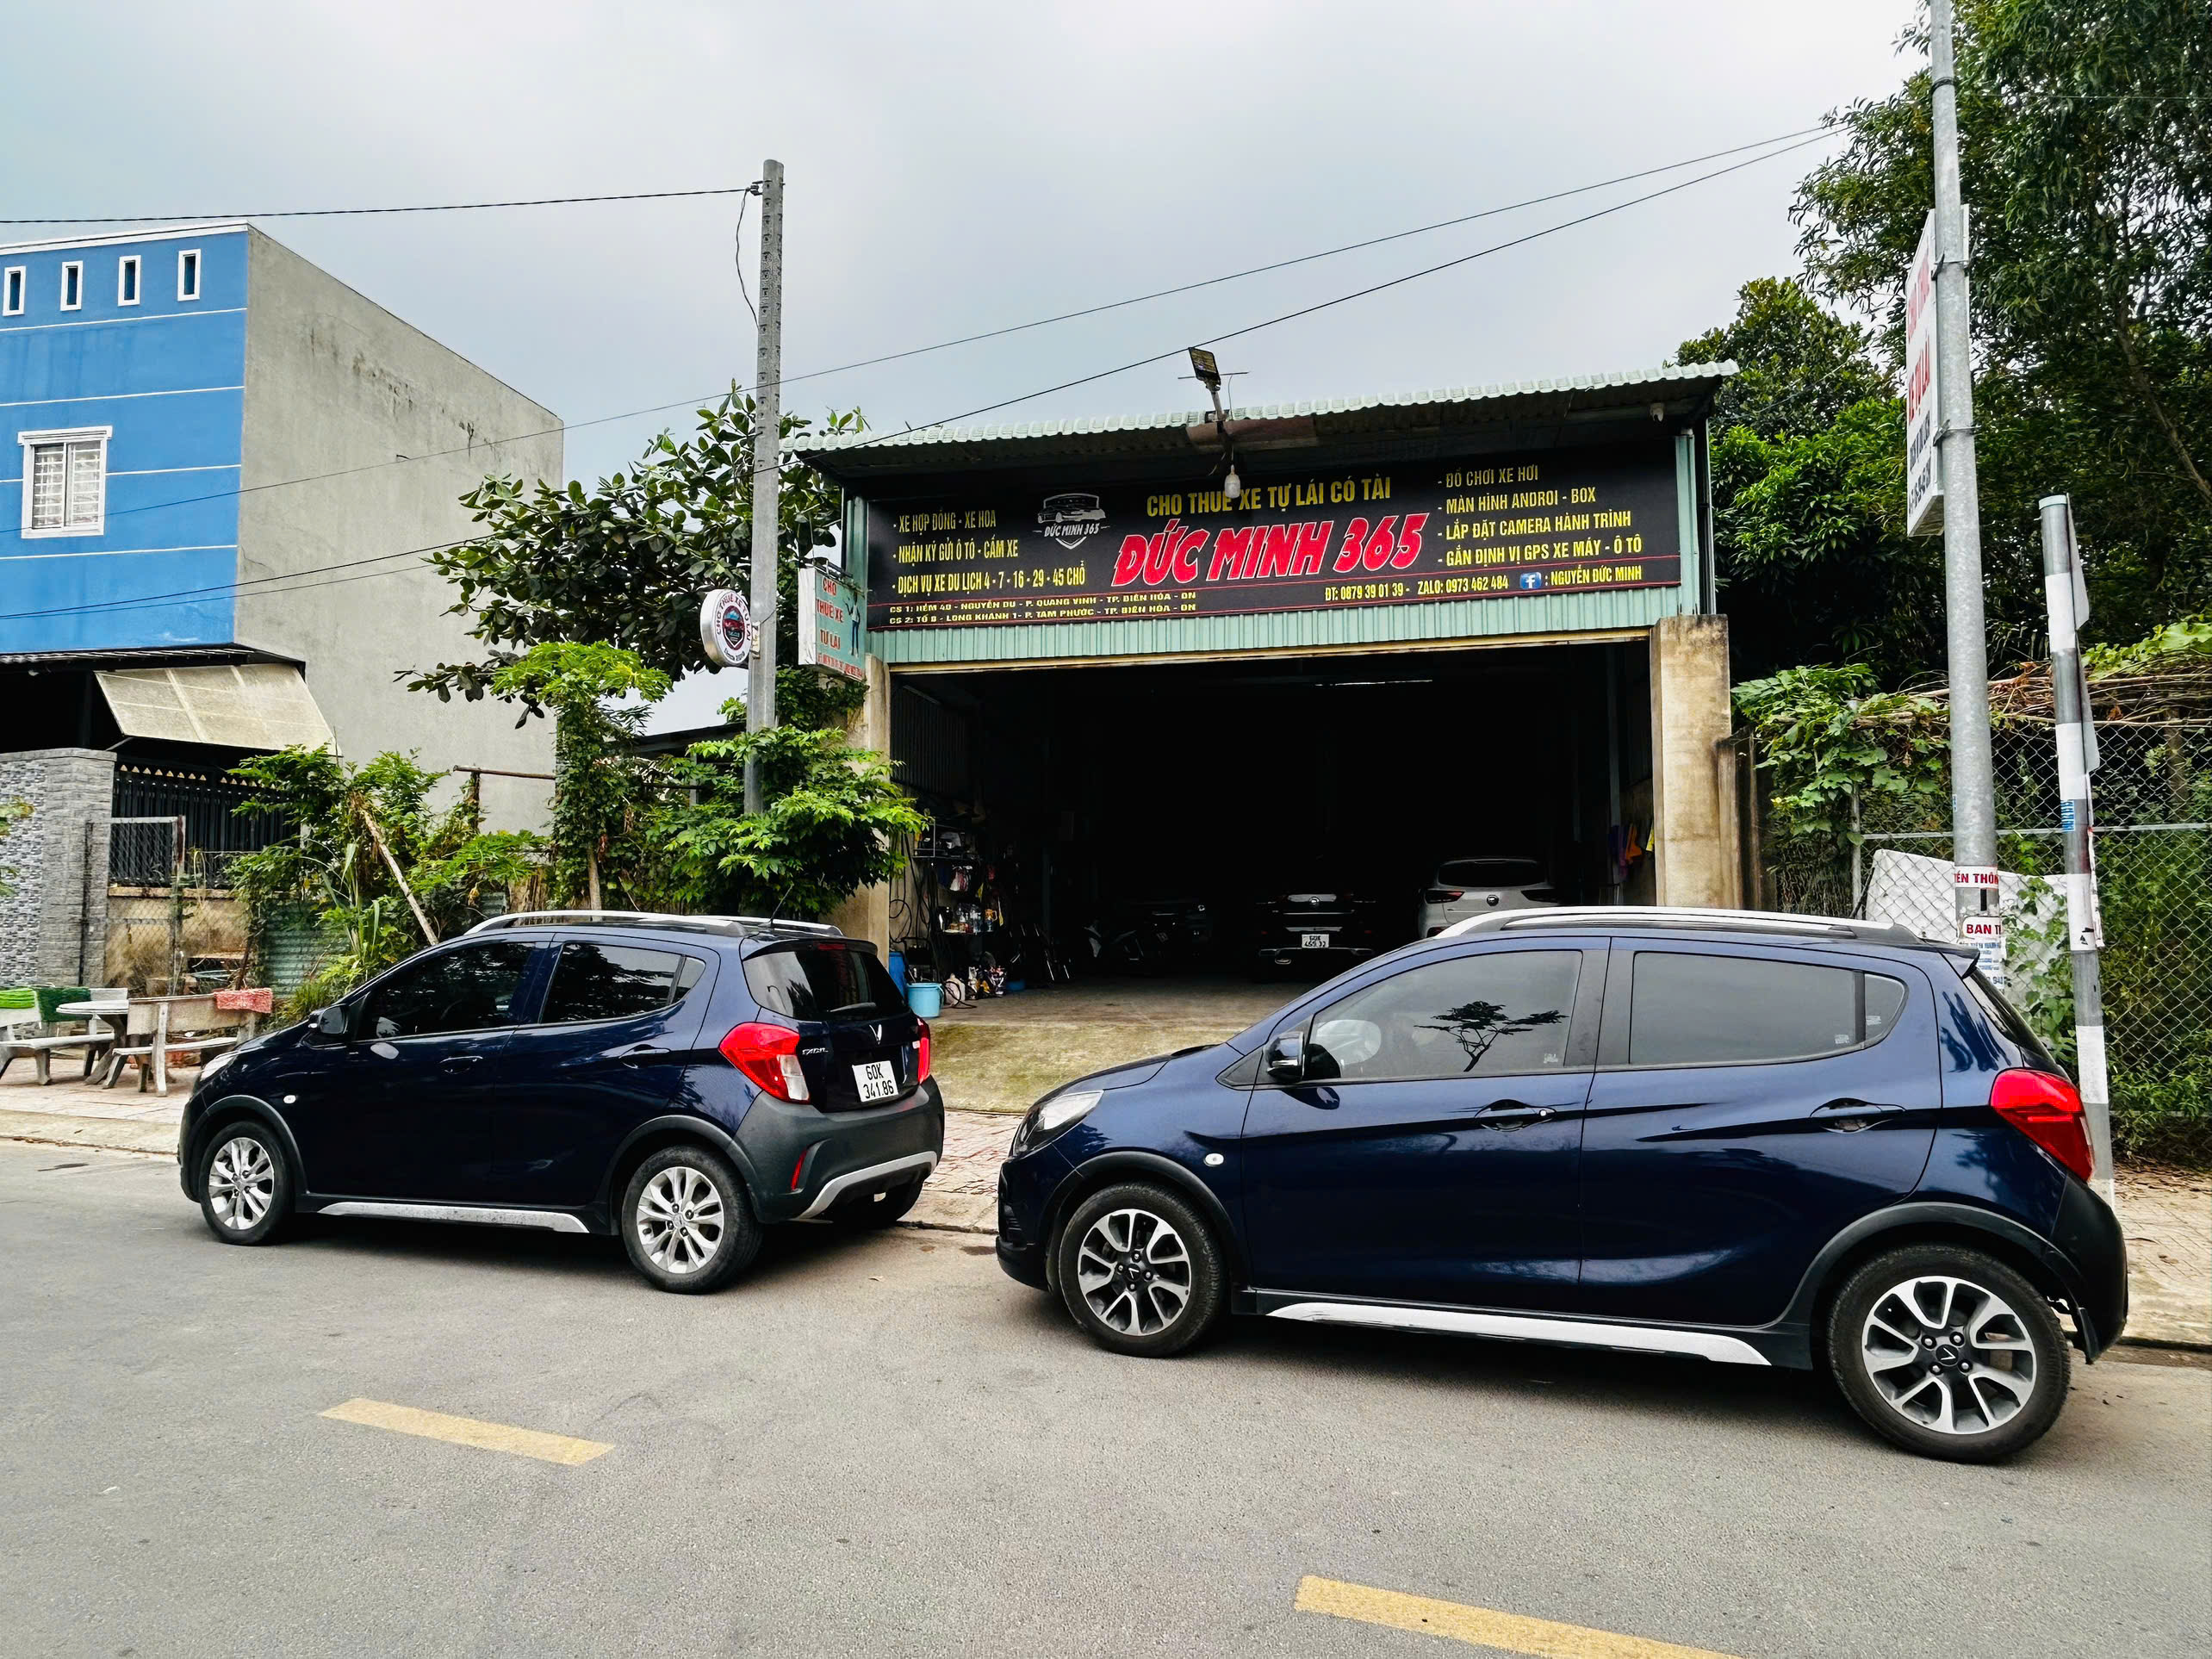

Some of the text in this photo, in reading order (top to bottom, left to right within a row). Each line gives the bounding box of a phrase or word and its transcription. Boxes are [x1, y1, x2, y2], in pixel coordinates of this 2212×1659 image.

[1466, 469, 1494, 487] CHƠI
[1499, 468, 1513, 483] XE
[1518, 464, 1538, 481] HƠI
[1147, 495, 1182, 516] CHO
[1239, 488, 1261, 510] XE
[1267, 482, 1290, 513] TỰ
[1296, 479, 1324, 506] LÁI
[1331, 475, 1356, 503] CÓ
[1446, 494, 1474, 514] MÀN
[1478, 492, 1507, 511] HÌNH
[1512, 490, 1558, 508] ANDROI
[1571, 487, 1595, 503] BOX
[899, 515, 910, 532] XE
[912, 514, 929, 535] HỢP
[965, 511, 975, 528] XE
[979, 510, 996, 527] HOA
[1062, 524, 1083, 536] MINH
[1084, 523, 1100, 534] 365
[1446, 519, 1468, 539] LẮP
[1472, 519, 1495, 541] ĐẶT
[1500, 517, 1551, 536] CAMERA
[1555, 513, 1589, 531] HÀNH
[1594, 508, 1631, 528] TRÌNH
[898, 542, 923, 566] NHẬN
[925, 538, 936, 562] KÝ
[939, 537, 953, 561] GỬI
[956, 539, 961, 560] Ô
[1007, 539, 1018, 557] XE
[1110, 513, 1430, 587] ĐỨC MINH 365
[1446, 544, 1471, 566] GẮN
[1475, 548, 1505, 567] ĐỊNH
[1508, 545, 1520, 564] VỊ
[1525, 544, 1550, 560] GPS
[1553, 542, 1569, 558] XE
[1574, 537, 1600, 556] MÁY
[1614, 535, 1622, 554] Ô
[1626, 533, 1642, 553] TÔ
[898, 575, 918, 597] DỊCH
[921, 574, 932, 596] VỤ
[935, 574, 945, 591] XE
[948, 573, 960, 591] DU
[962, 572, 981, 594] LỊCH
[984, 572, 990, 590] 4
[998, 571, 1004, 588] 7
[1013, 571, 1024, 588] 16
[1033, 569, 1044, 587] 29
[1053, 569, 1064, 586] 45
[1593, 565, 1612, 582] ĐỨC
[1615, 565, 1642, 581] MINH
[823, 578, 836, 595] CHO
[1340, 586, 1363, 600] 0879
[1365, 585, 1376, 599] 39
[1379, 584, 1389, 598] 01
[1393, 583, 1403, 596] 39
[1418, 580, 1444, 595] ZALO:
[1446, 577, 1469, 593] 0973
[1471, 576, 1488, 591] 462
[1491, 575, 1508, 589] 484
[835, 606, 844, 623] XE
[866, 1063, 884, 1080] 60K
[863, 1079, 894, 1099] 341.86
